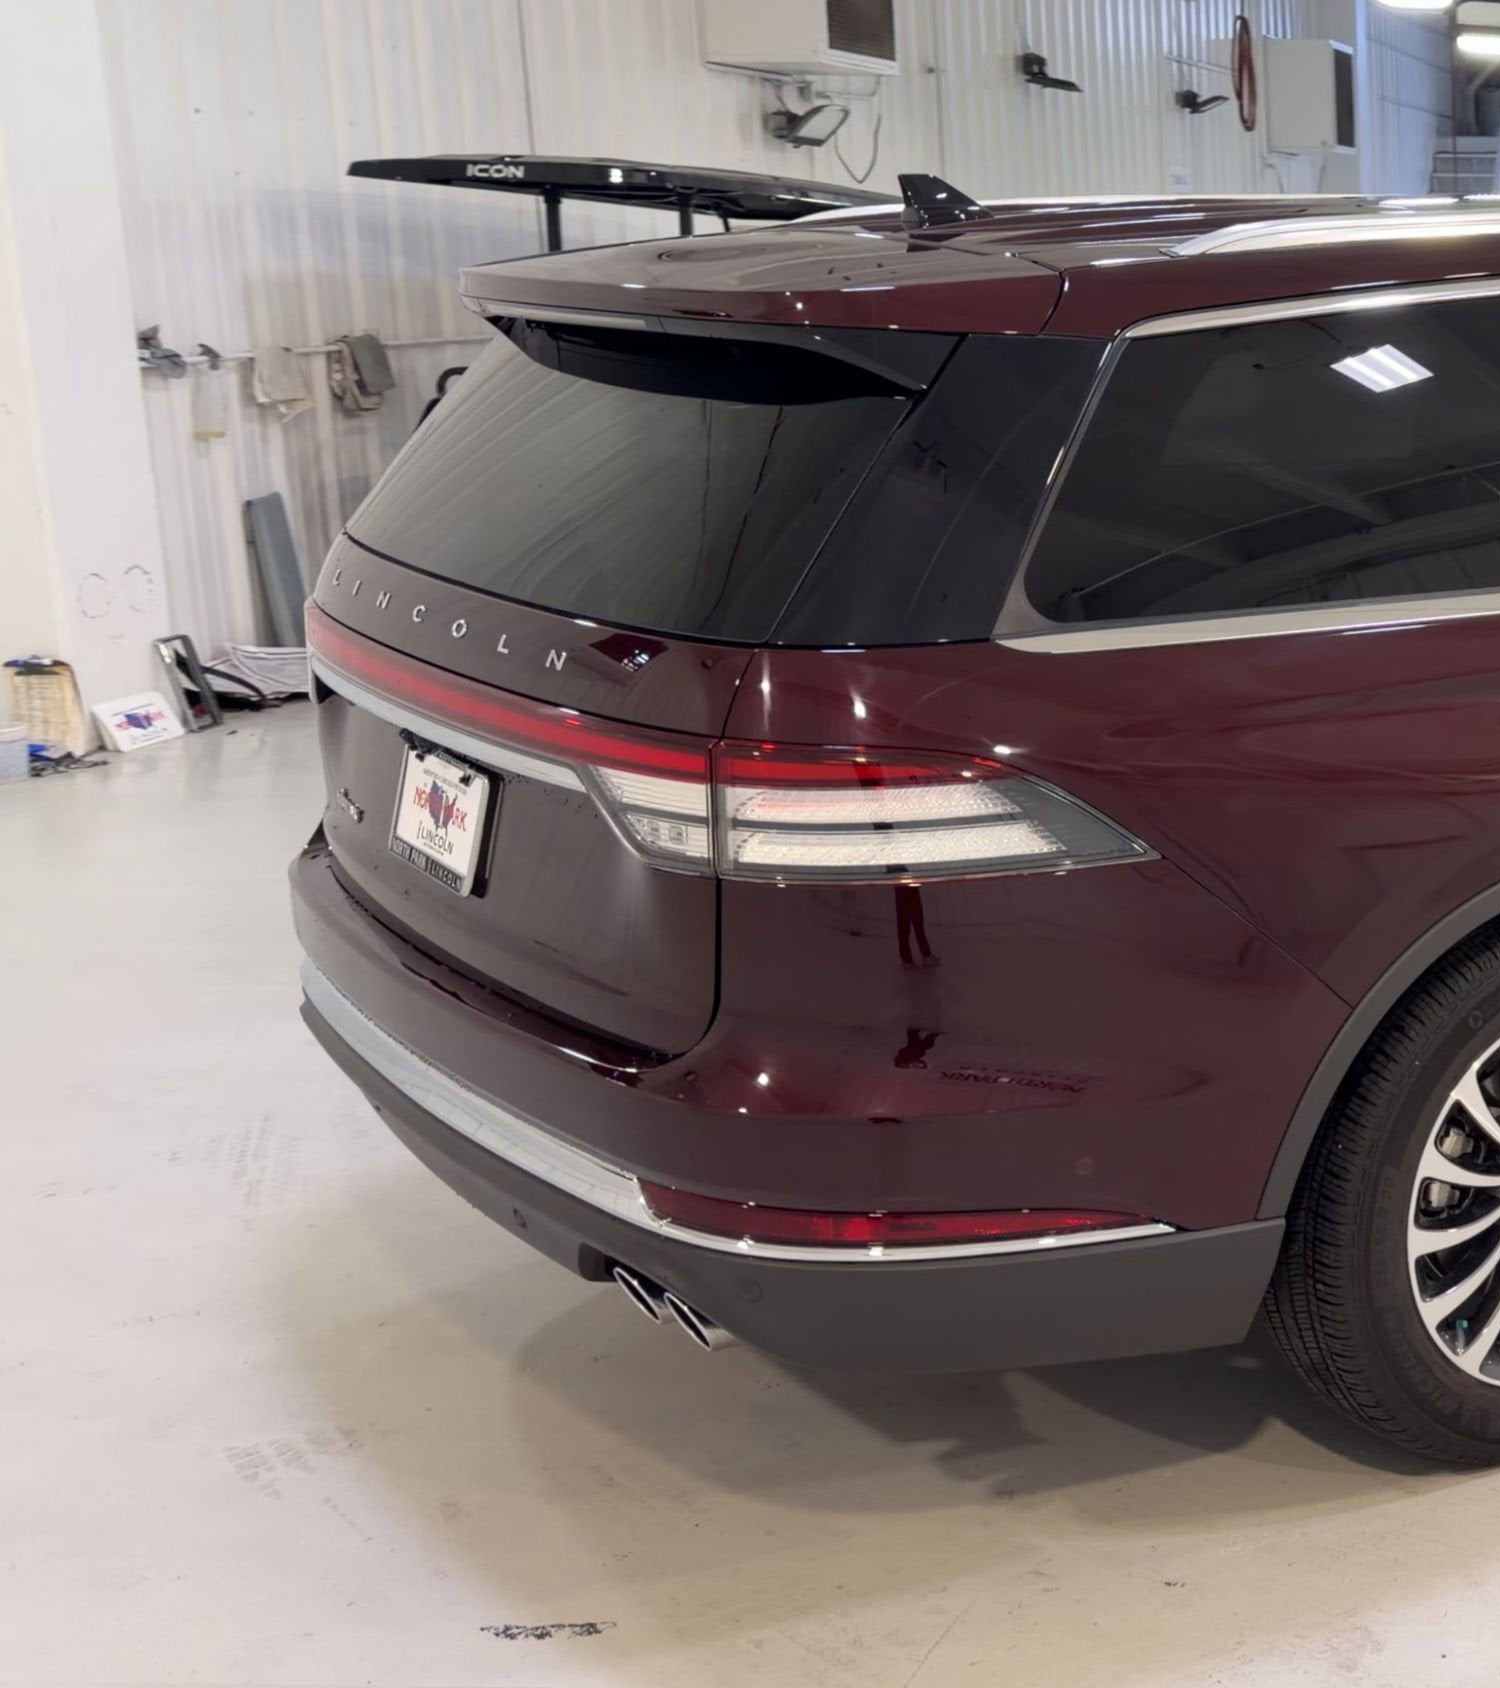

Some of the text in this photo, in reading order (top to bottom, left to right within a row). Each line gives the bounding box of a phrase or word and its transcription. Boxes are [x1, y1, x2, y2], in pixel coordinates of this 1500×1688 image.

[466, 163, 526, 178] ICON
[332, 568, 567, 672] LINCOLN
[420, 827, 455, 855] LINCOLN
